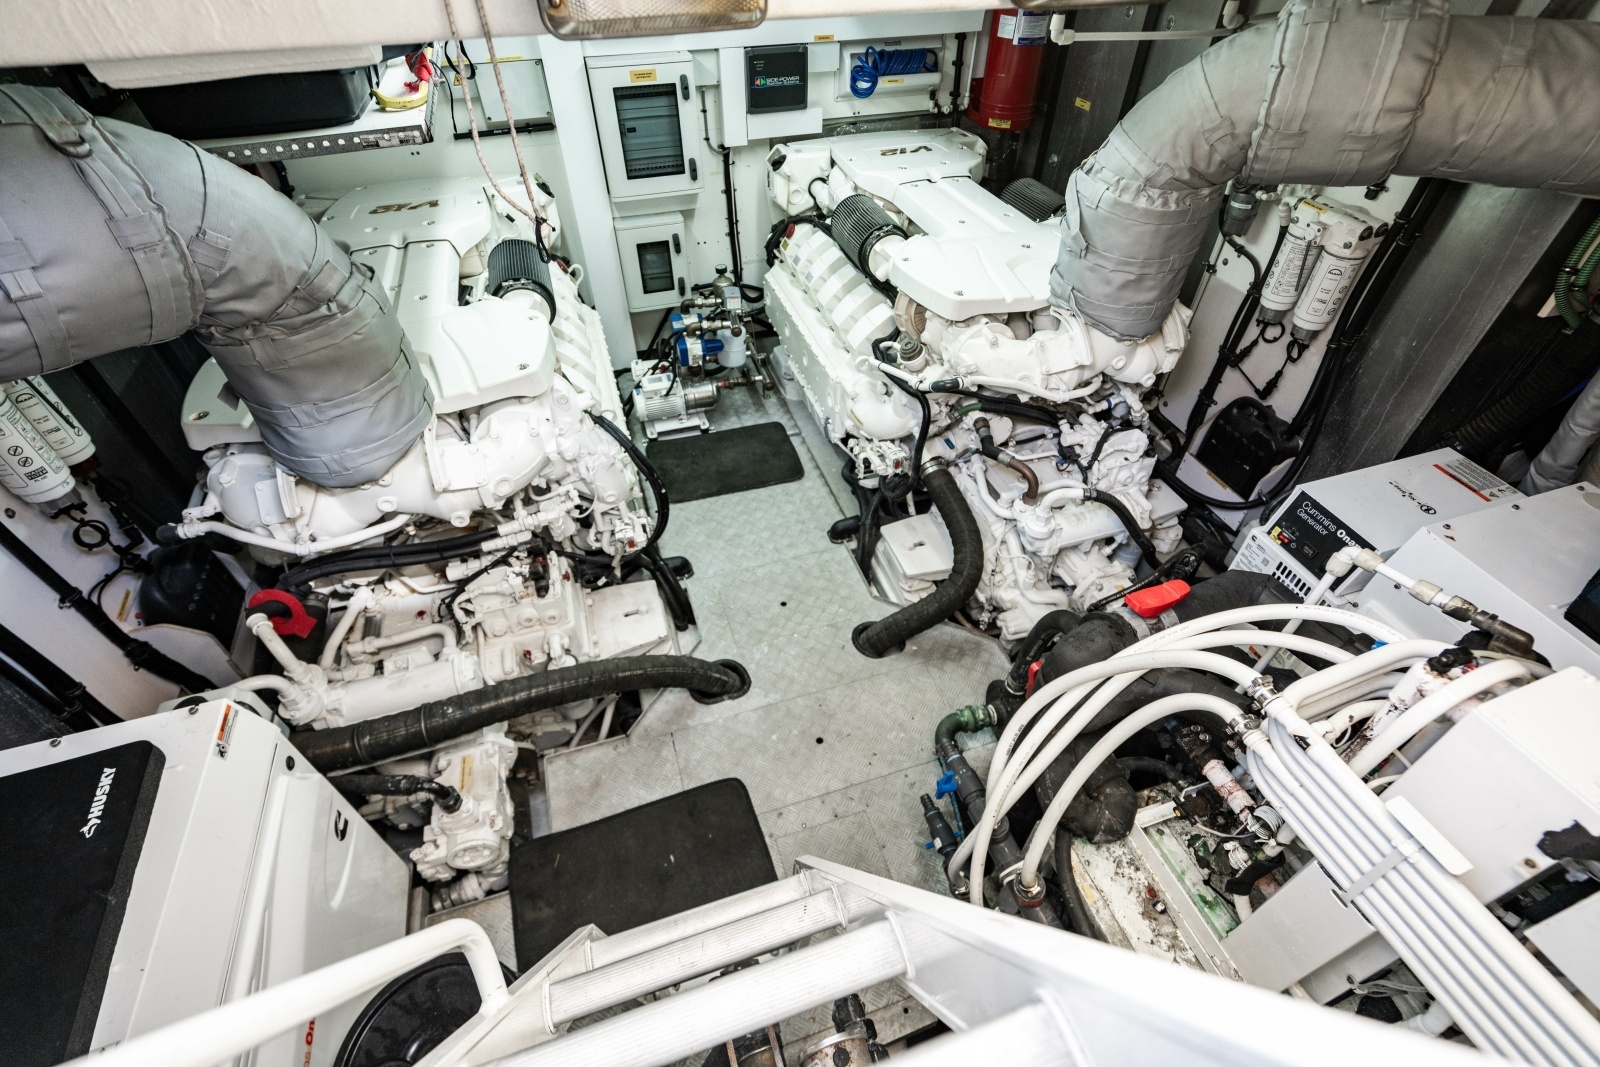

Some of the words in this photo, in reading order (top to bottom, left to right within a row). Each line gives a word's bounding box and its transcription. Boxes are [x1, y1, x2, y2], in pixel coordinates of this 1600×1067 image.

[880, 145, 933, 156] V12
[24, 466, 46, 477] MANN
[28, 469, 48, 480] FILTER
[1296, 508, 1329, 536] Generator
[1302, 501, 1337, 532] Cummins
[87, 767, 117, 819] HUSKY
